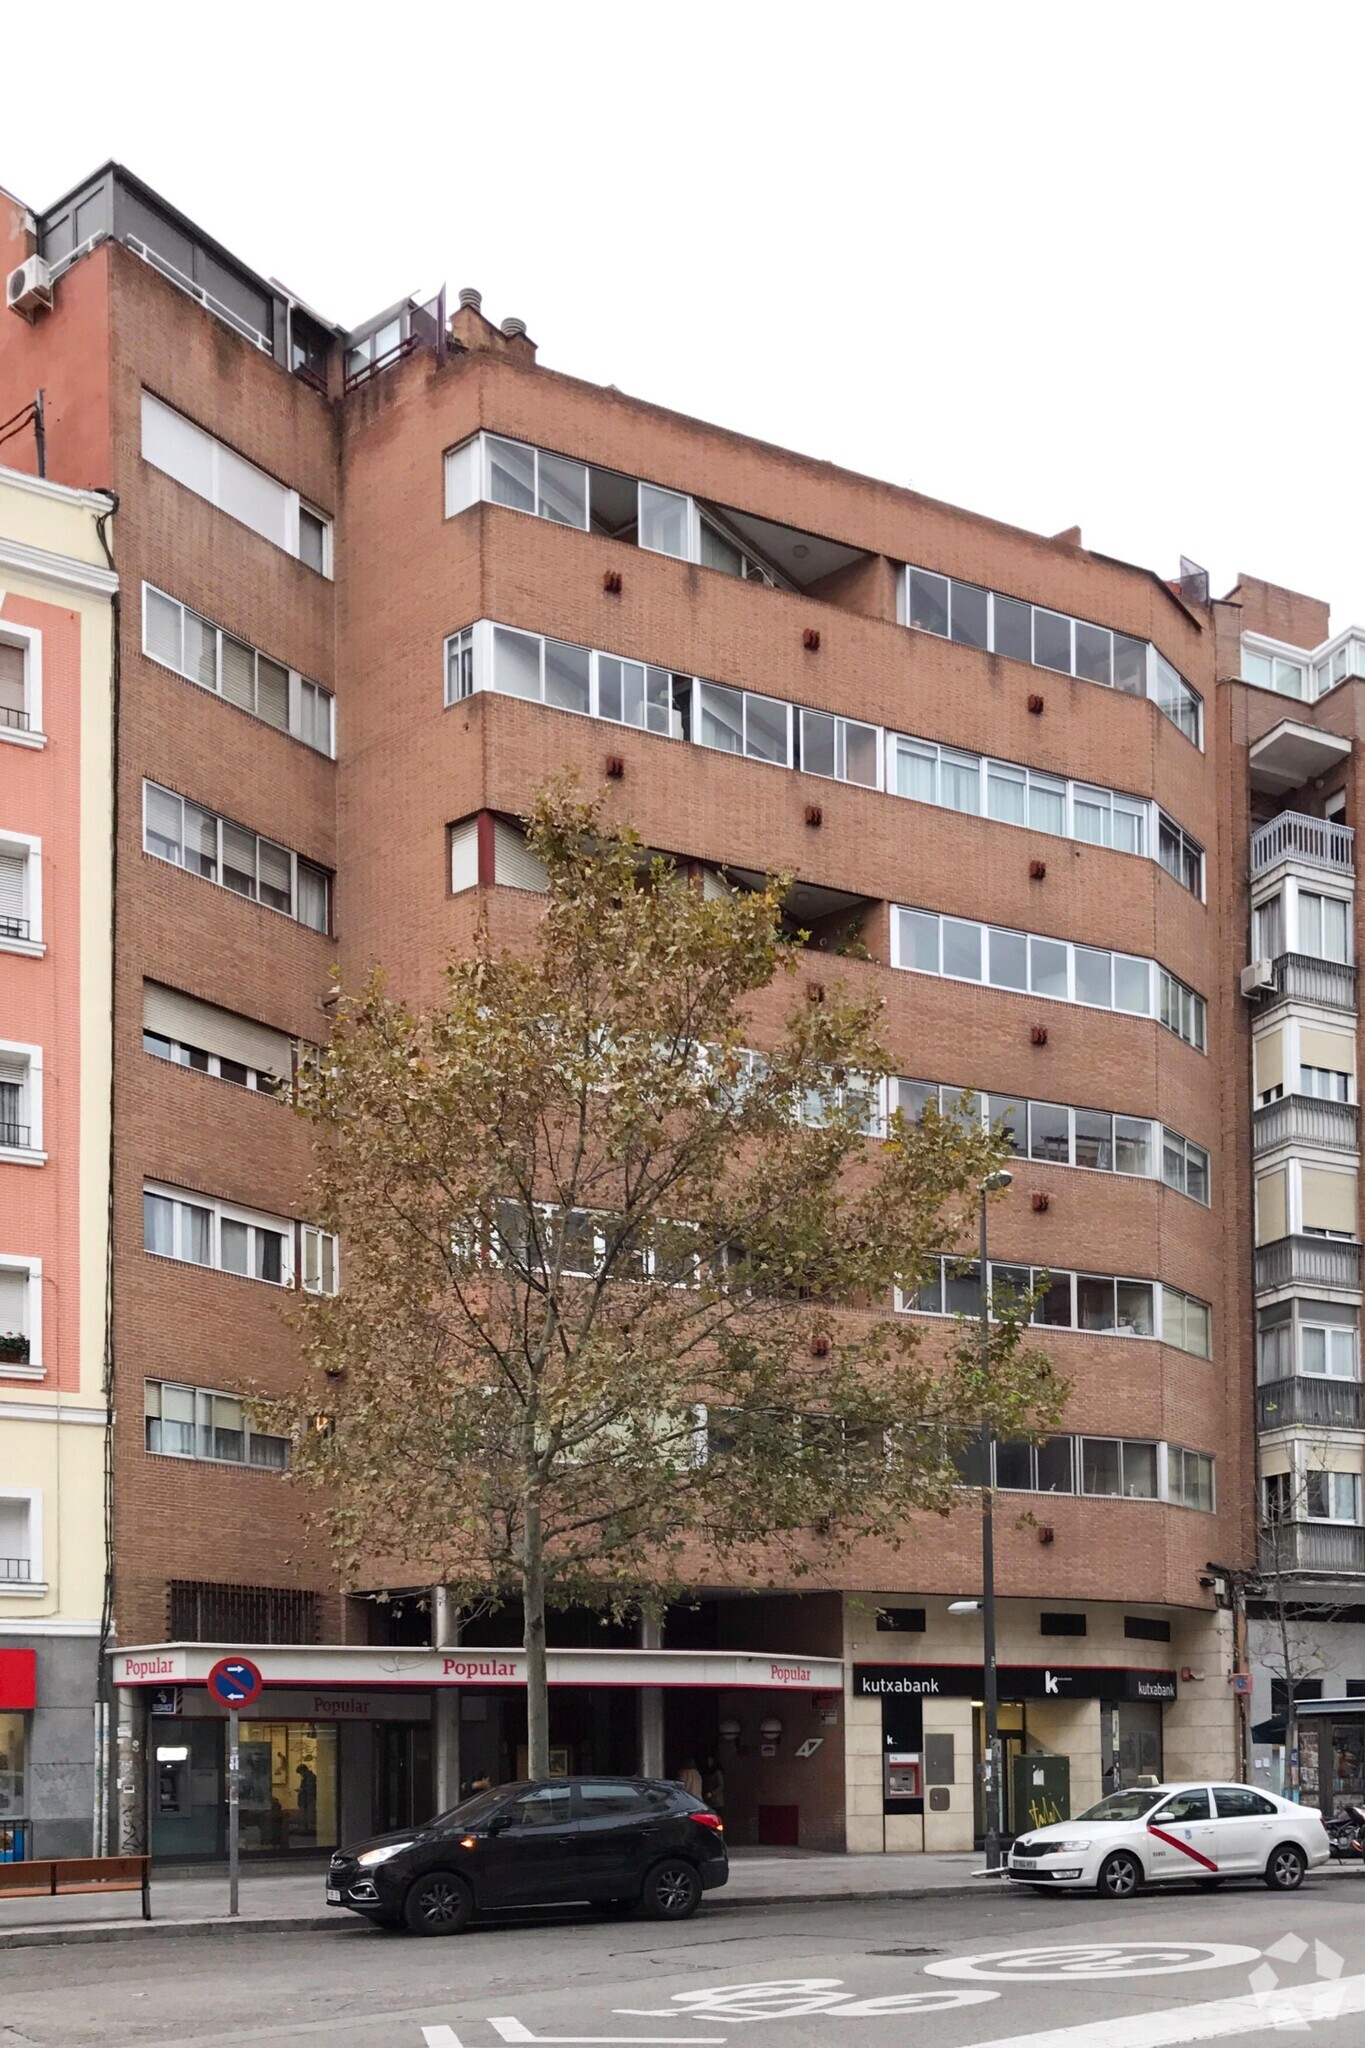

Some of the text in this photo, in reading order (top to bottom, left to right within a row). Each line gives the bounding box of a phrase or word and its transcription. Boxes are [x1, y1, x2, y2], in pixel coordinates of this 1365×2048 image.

[125, 1658, 174, 1679] Popular
[442, 1658, 517, 1680] Popular
[771, 1664, 811, 1684] Popular
[862, 1677, 940, 1694] kutxabank
[1045, 1670, 1059, 1694] k
[1138, 1681, 1175, 1698] kutxabank
[314, 1697, 370, 1716] Popular
[996, 1949, 1190, 1972] 30
